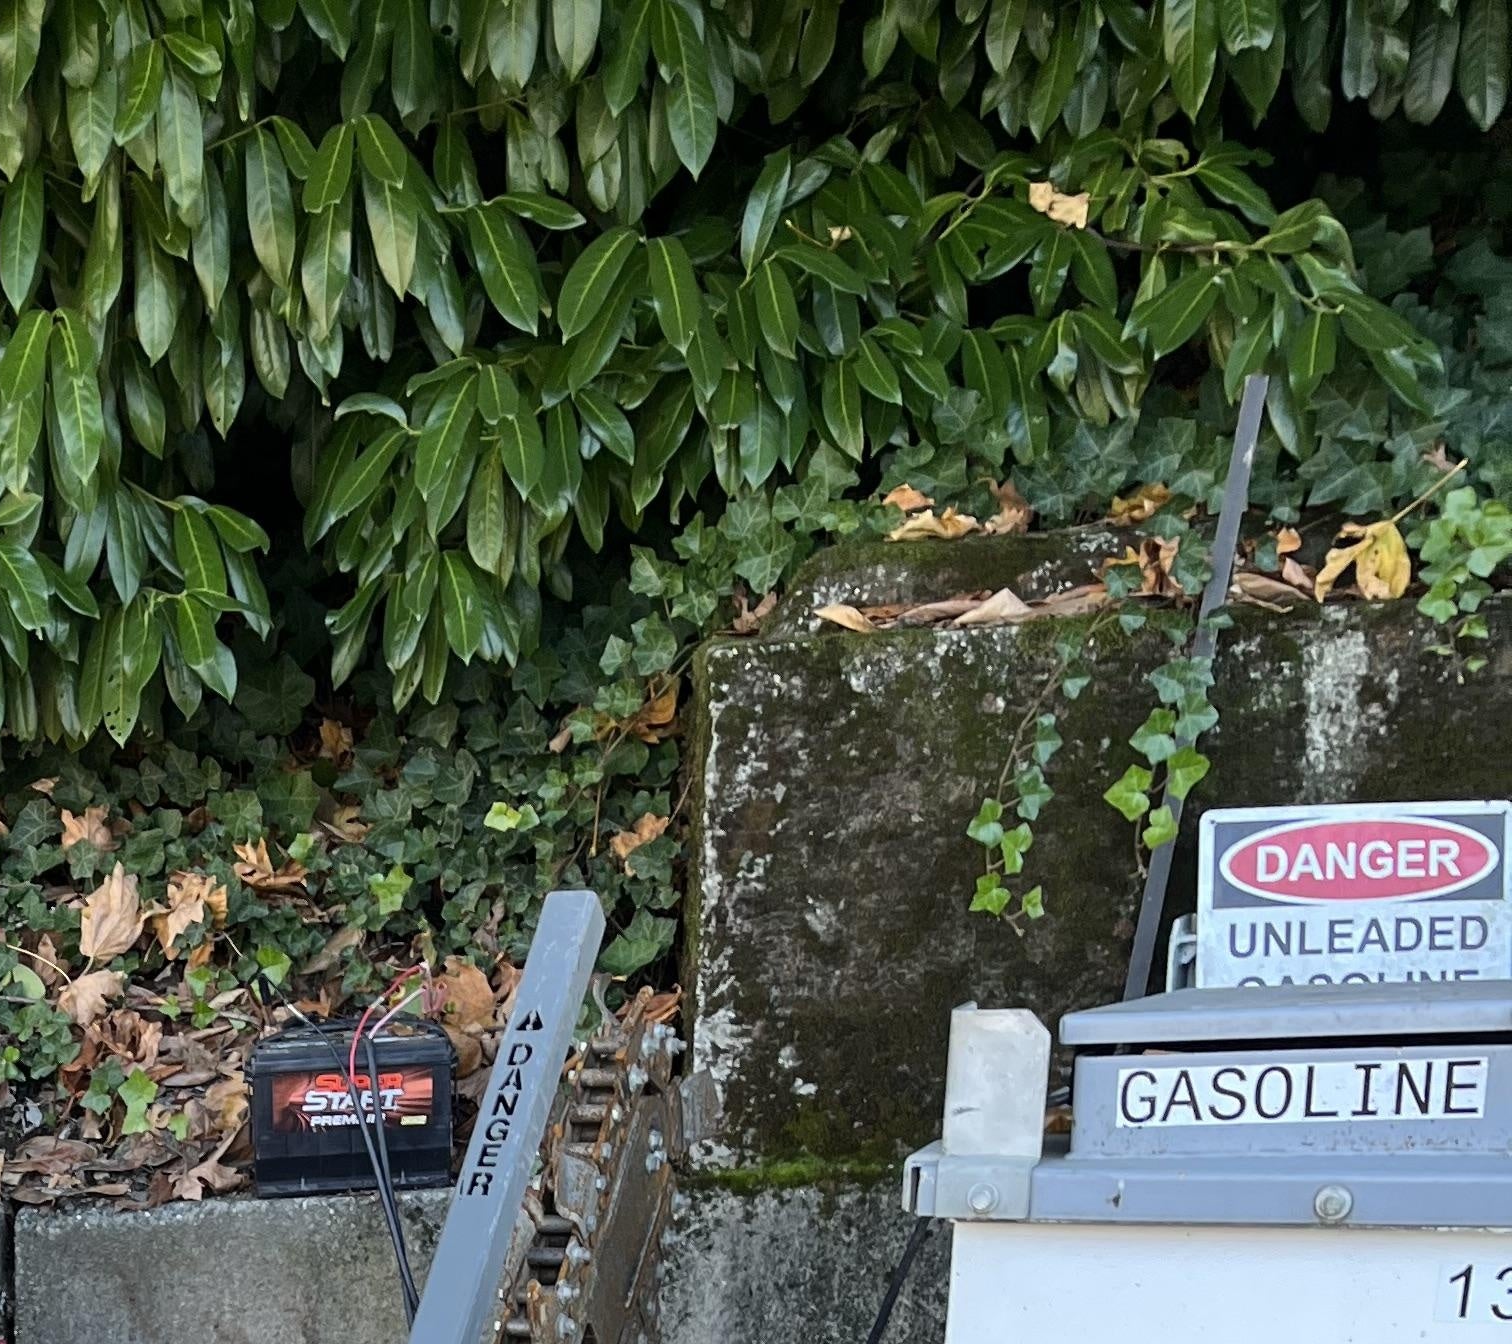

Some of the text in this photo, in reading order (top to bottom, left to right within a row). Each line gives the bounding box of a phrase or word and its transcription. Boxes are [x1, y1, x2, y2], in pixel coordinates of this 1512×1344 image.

[1256, 839, 1460, 884] DANGER
[1229, 916, 1488, 958] UNLEADED
[1120, 1060, 1483, 1123] GASOLINE
[466, 1043, 532, 1196] DANGER
